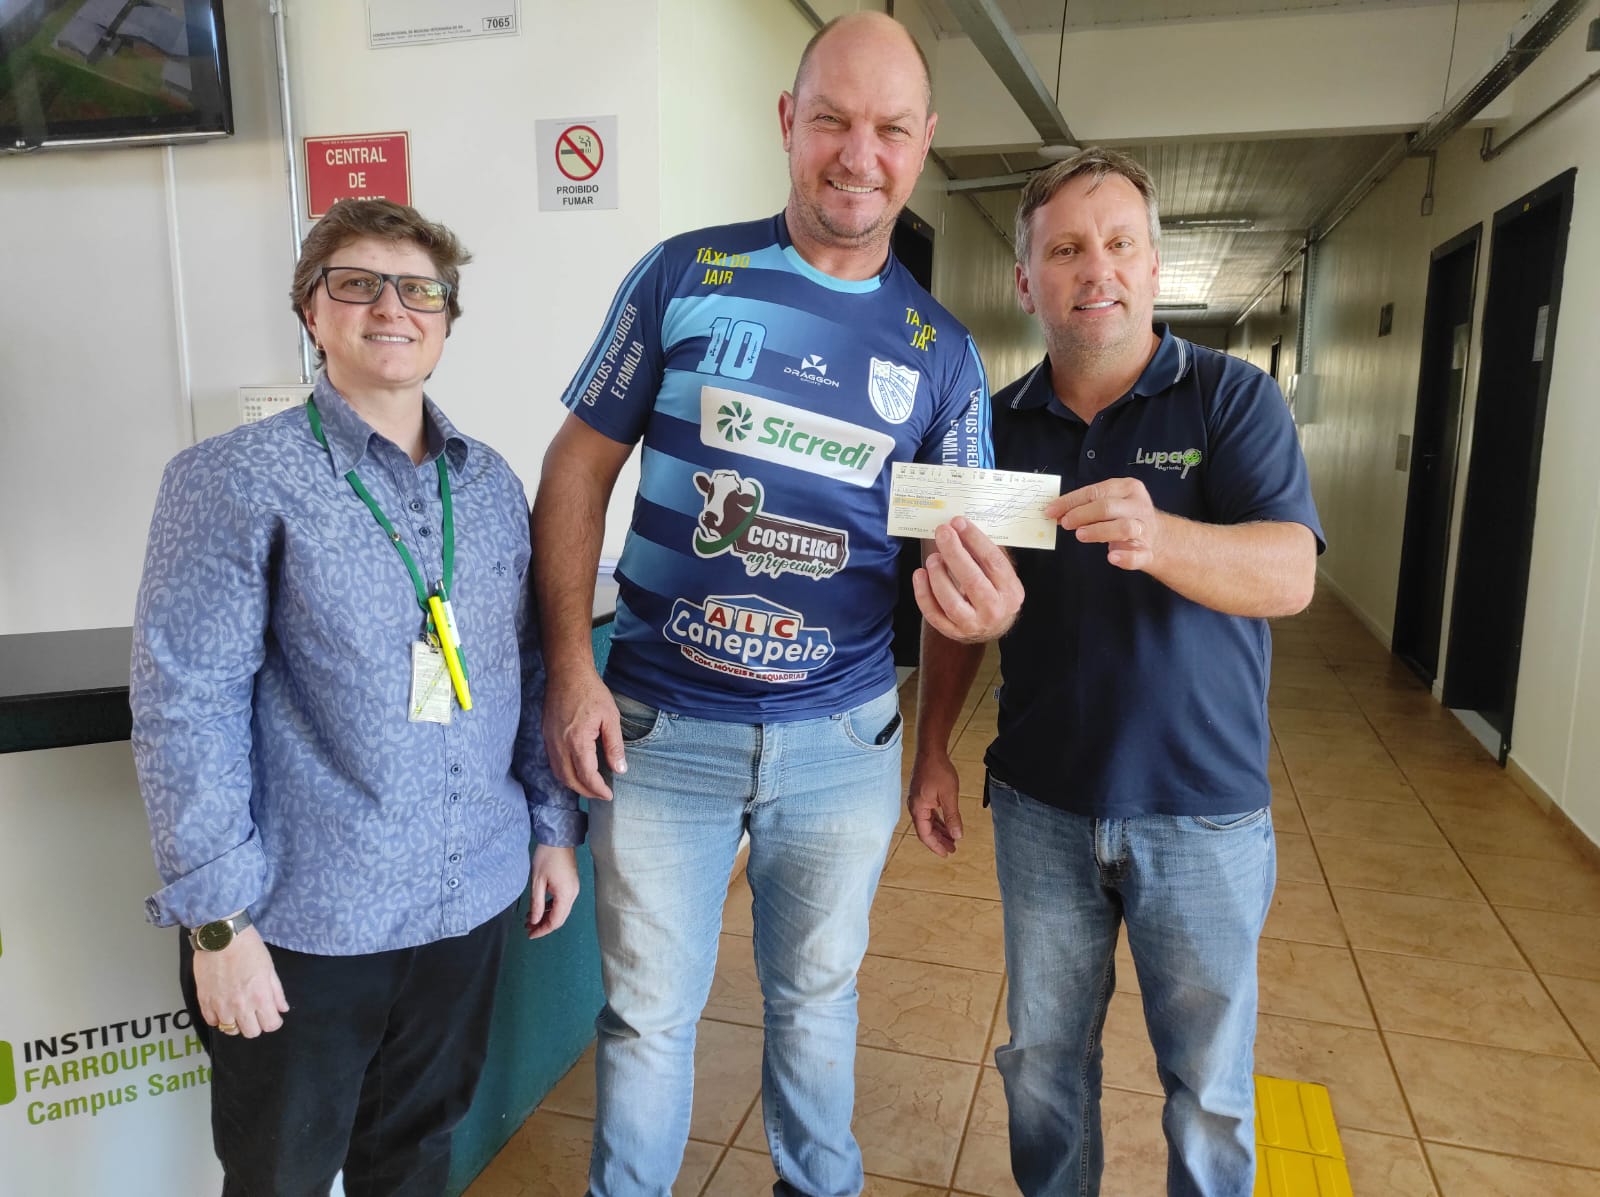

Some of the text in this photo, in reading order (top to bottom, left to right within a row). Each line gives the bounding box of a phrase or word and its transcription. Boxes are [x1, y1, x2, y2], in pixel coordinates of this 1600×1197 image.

[486, 17, 511, 29] 7065
[325, 146, 388, 166] CENTRAL
[348, 172, 367, 189] DE
[556, 184, 599, 195] PROIBIDO
[562, 196, 594, 206] FUMAR
[696, 247, 750, 269] TÁXI DO
[702, 268, 734, 285] JAIR
[582, 303, 638, 407] CARLOS PREDIGER
[696, 317, 767, 380] 10
[611, 341, 645, 401] E FAMÍLIA
[783, 367, 840, 388] DRAGGON
[757, 417, 876, 470] Sicredi
[966, 436, 979, 467] PRED
[748, 526, 838, 559] COSTEIRO
[672, 610, 829, 665] Caneppele
[708, 607, 795, 638] ALC
[694, 655, 713, 668] COM.
[714, 663, 748, 676] MÓVEIS
[24, 1008, 193, 1063] INSTITUTO
[24, 1034, 202, 1093] FARROUPILH
[27, 1084, 138, 1125] Campus
